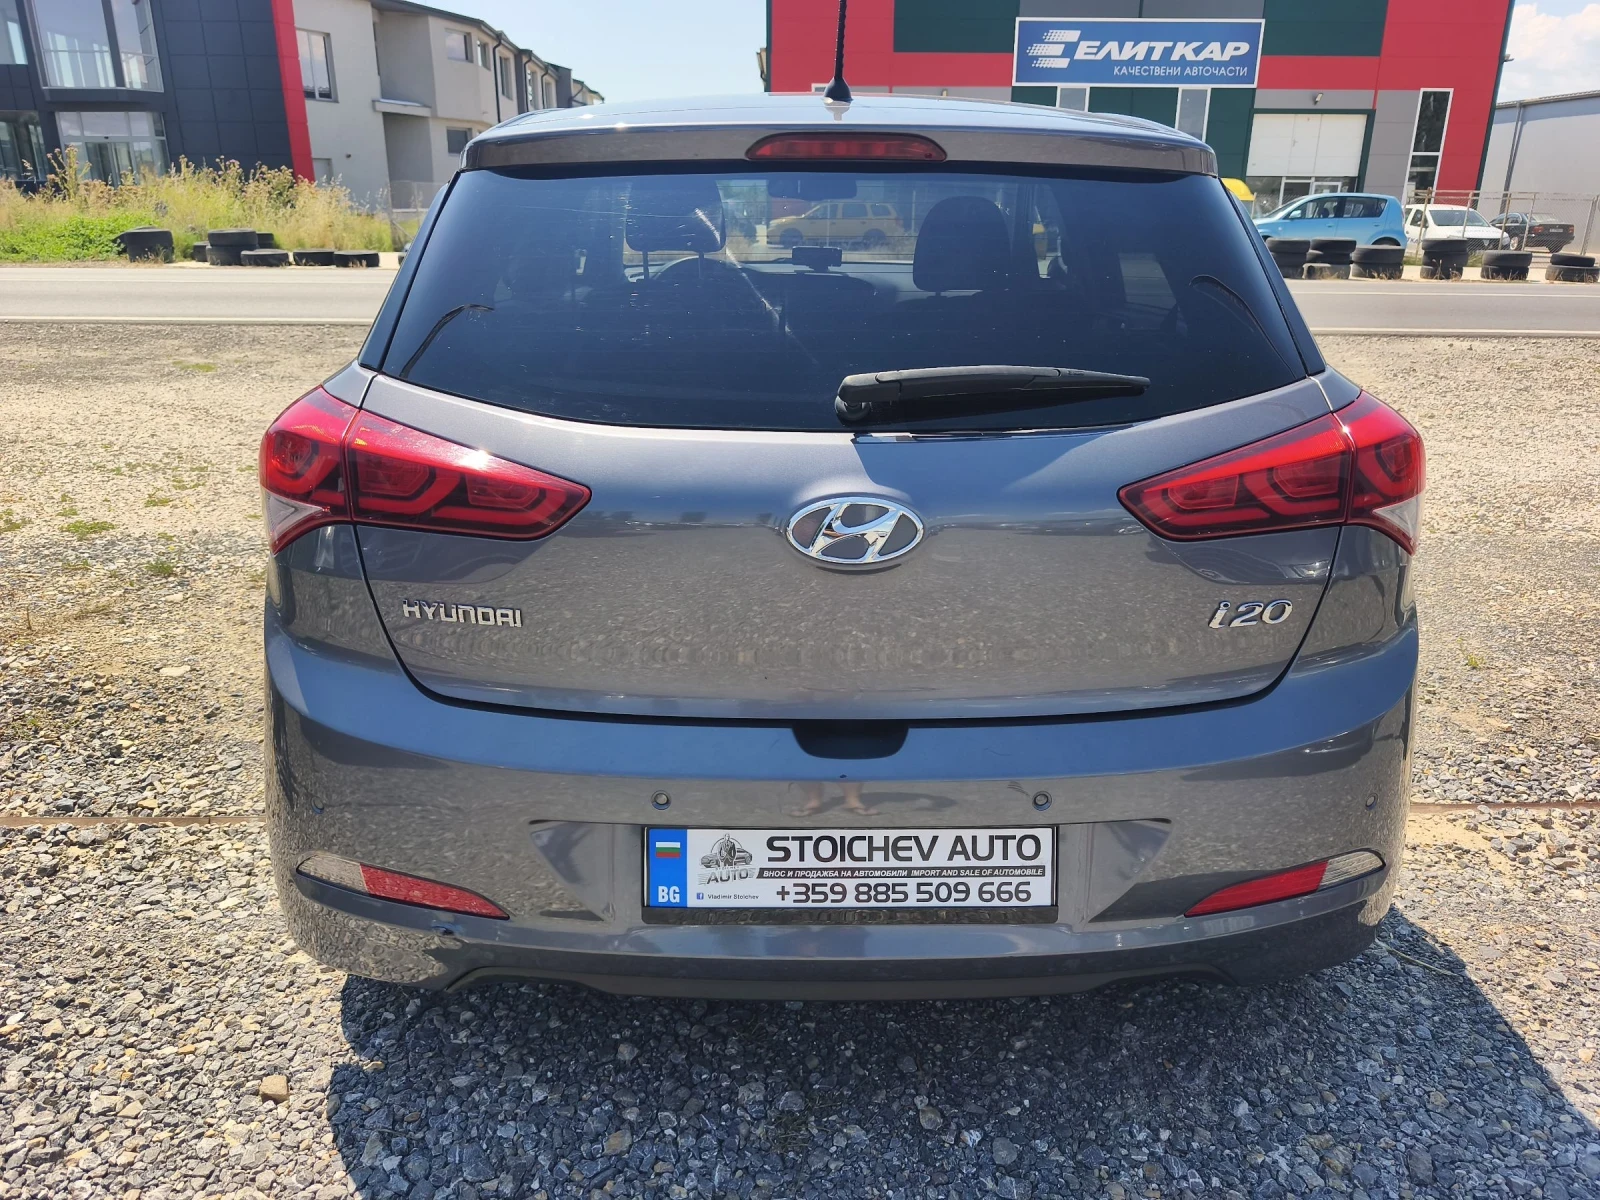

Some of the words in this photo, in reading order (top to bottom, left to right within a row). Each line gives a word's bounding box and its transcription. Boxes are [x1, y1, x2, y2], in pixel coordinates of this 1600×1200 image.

[1113, 65, 1181, 76] КАЧЕСТВЕНИ
[1184, 66, 1248, 77] АВТОЧАСТИ
[402, 599, 522, 628] HYUNDAI
[1208, 598, 1293, 629] i20
[766, 834, 939, 863] STOICHEV
[947, 833, 1042, 862] AUTO
[706, 868, 749, 885] AUTO
[763, 870, 786, 878] ВНОС
[787, 870, 794, 878] И
[794, 870, 839, 878] ПРОДАЖБА
[853, 869, 908, 877] АВТОМОБИЛИ
[911, 869, 941, 877] IMPORT
[942, 869, 958, 877] AND
[993, 868, 1043, 876] AUTOMOBILE
[657, 885, 680, 903] BG
[776, 882, 847, 904] +359
[854, 882, 909, 903] 885
[916, 881, 971, 903] 509
[977, 881, 1032, 903] 666
